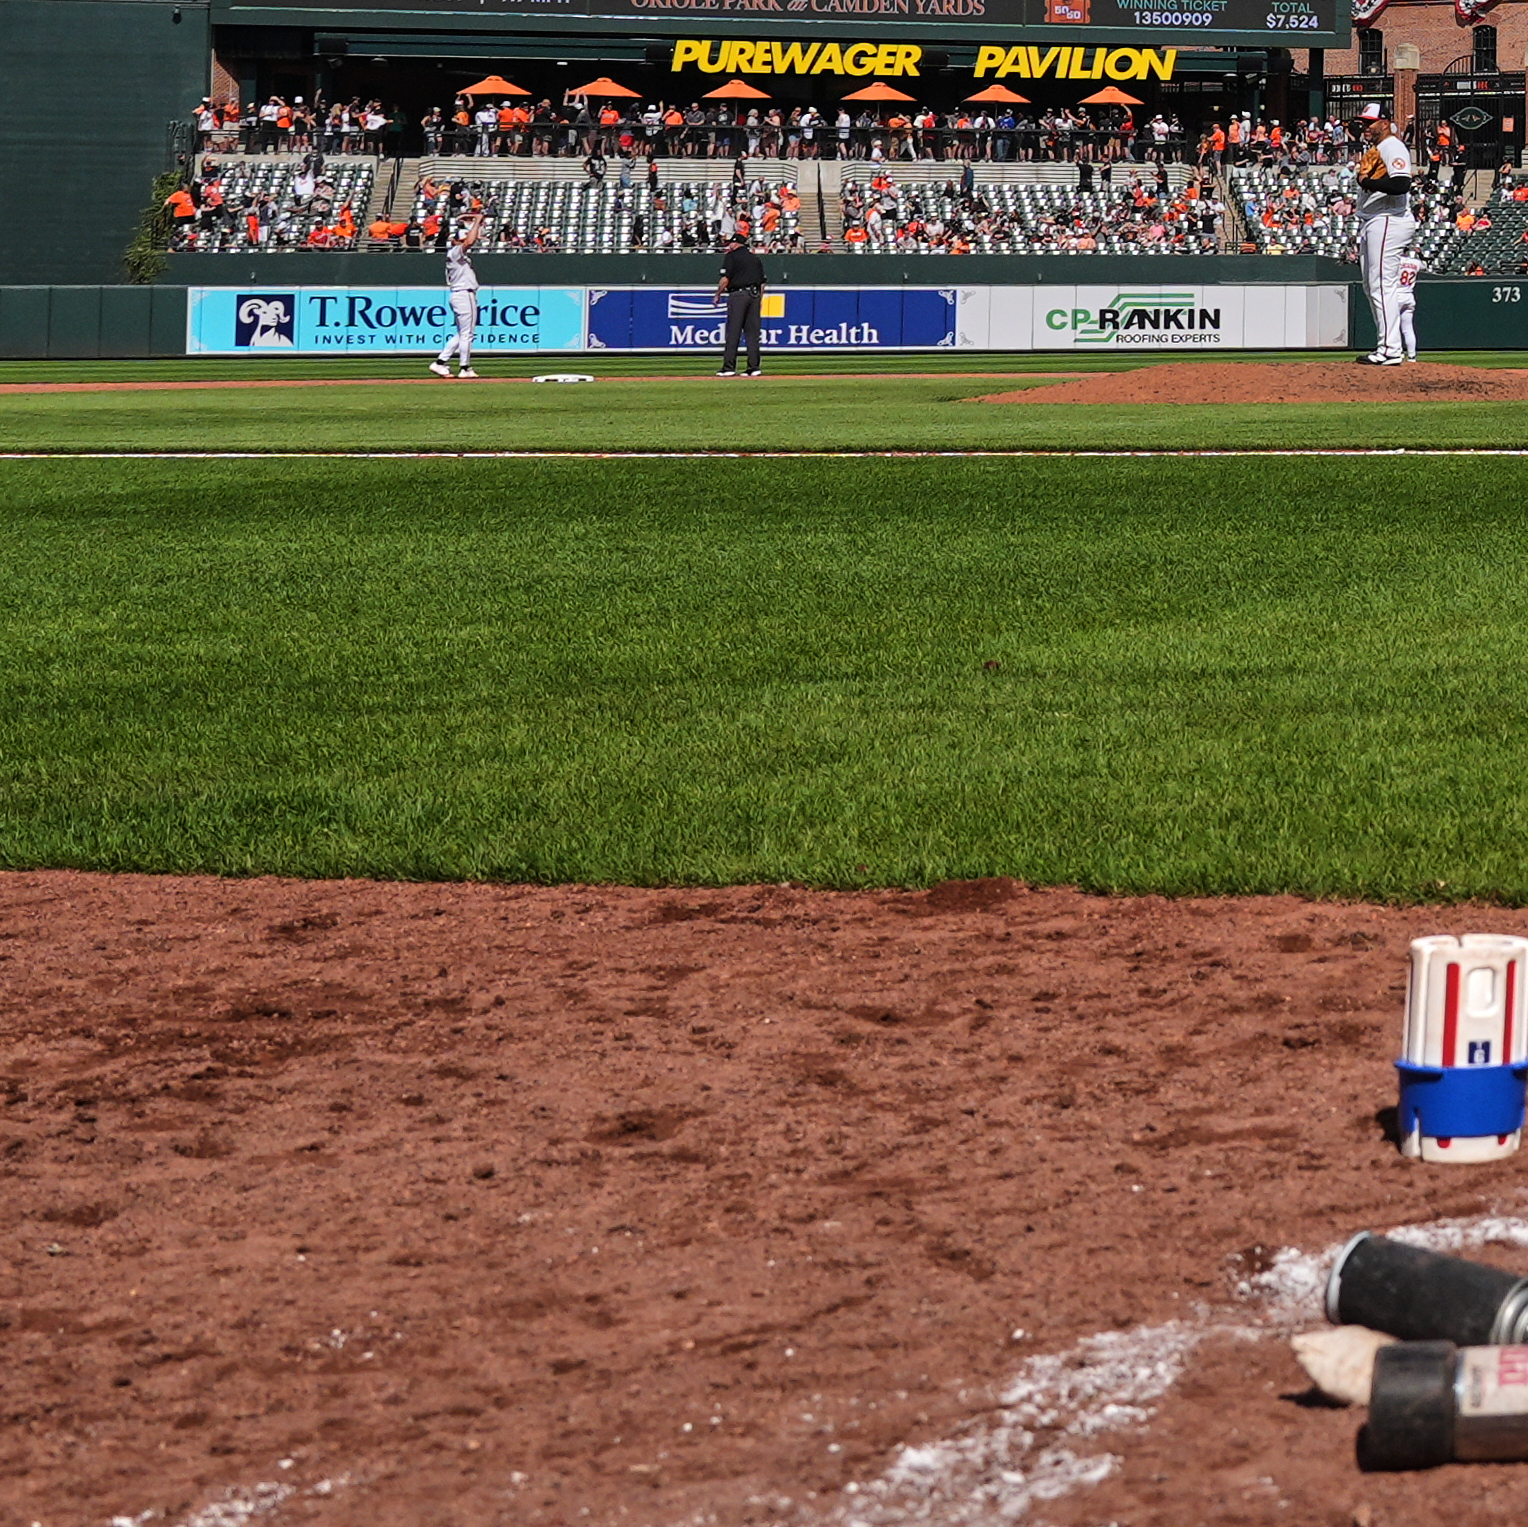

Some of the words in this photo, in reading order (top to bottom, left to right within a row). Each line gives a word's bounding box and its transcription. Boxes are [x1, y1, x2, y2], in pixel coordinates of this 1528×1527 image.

[1181, 0, 1228, 12] TICKET
[1272, 2, 1314, 13] TOTAL
[1134, 11, 1212, 26] 13500909
[1266, 13, 1318, 28] $7,524
[671, 39, 922, 76] PUREWAGER
[973, 46, 1177, 81] PAVILION
[1400, 271, 1416, 286] 82
[1492, 286, 1522, 303] 373
[451, 298, 540, 327] rice
[1100, 308, 1220, 330] RANKIN
[315, 334, 376, 345] INVEST
[385, 334, 425, 344] WITH
[433, 333, 540, 344] COFIDENCE
[670, 322, 782, 345] Medar
[788, 322, 880, 344] Health
[1116, 334, 1168, 343] ROOFING
[1171, 334, 1220, 343] EXPERTS
